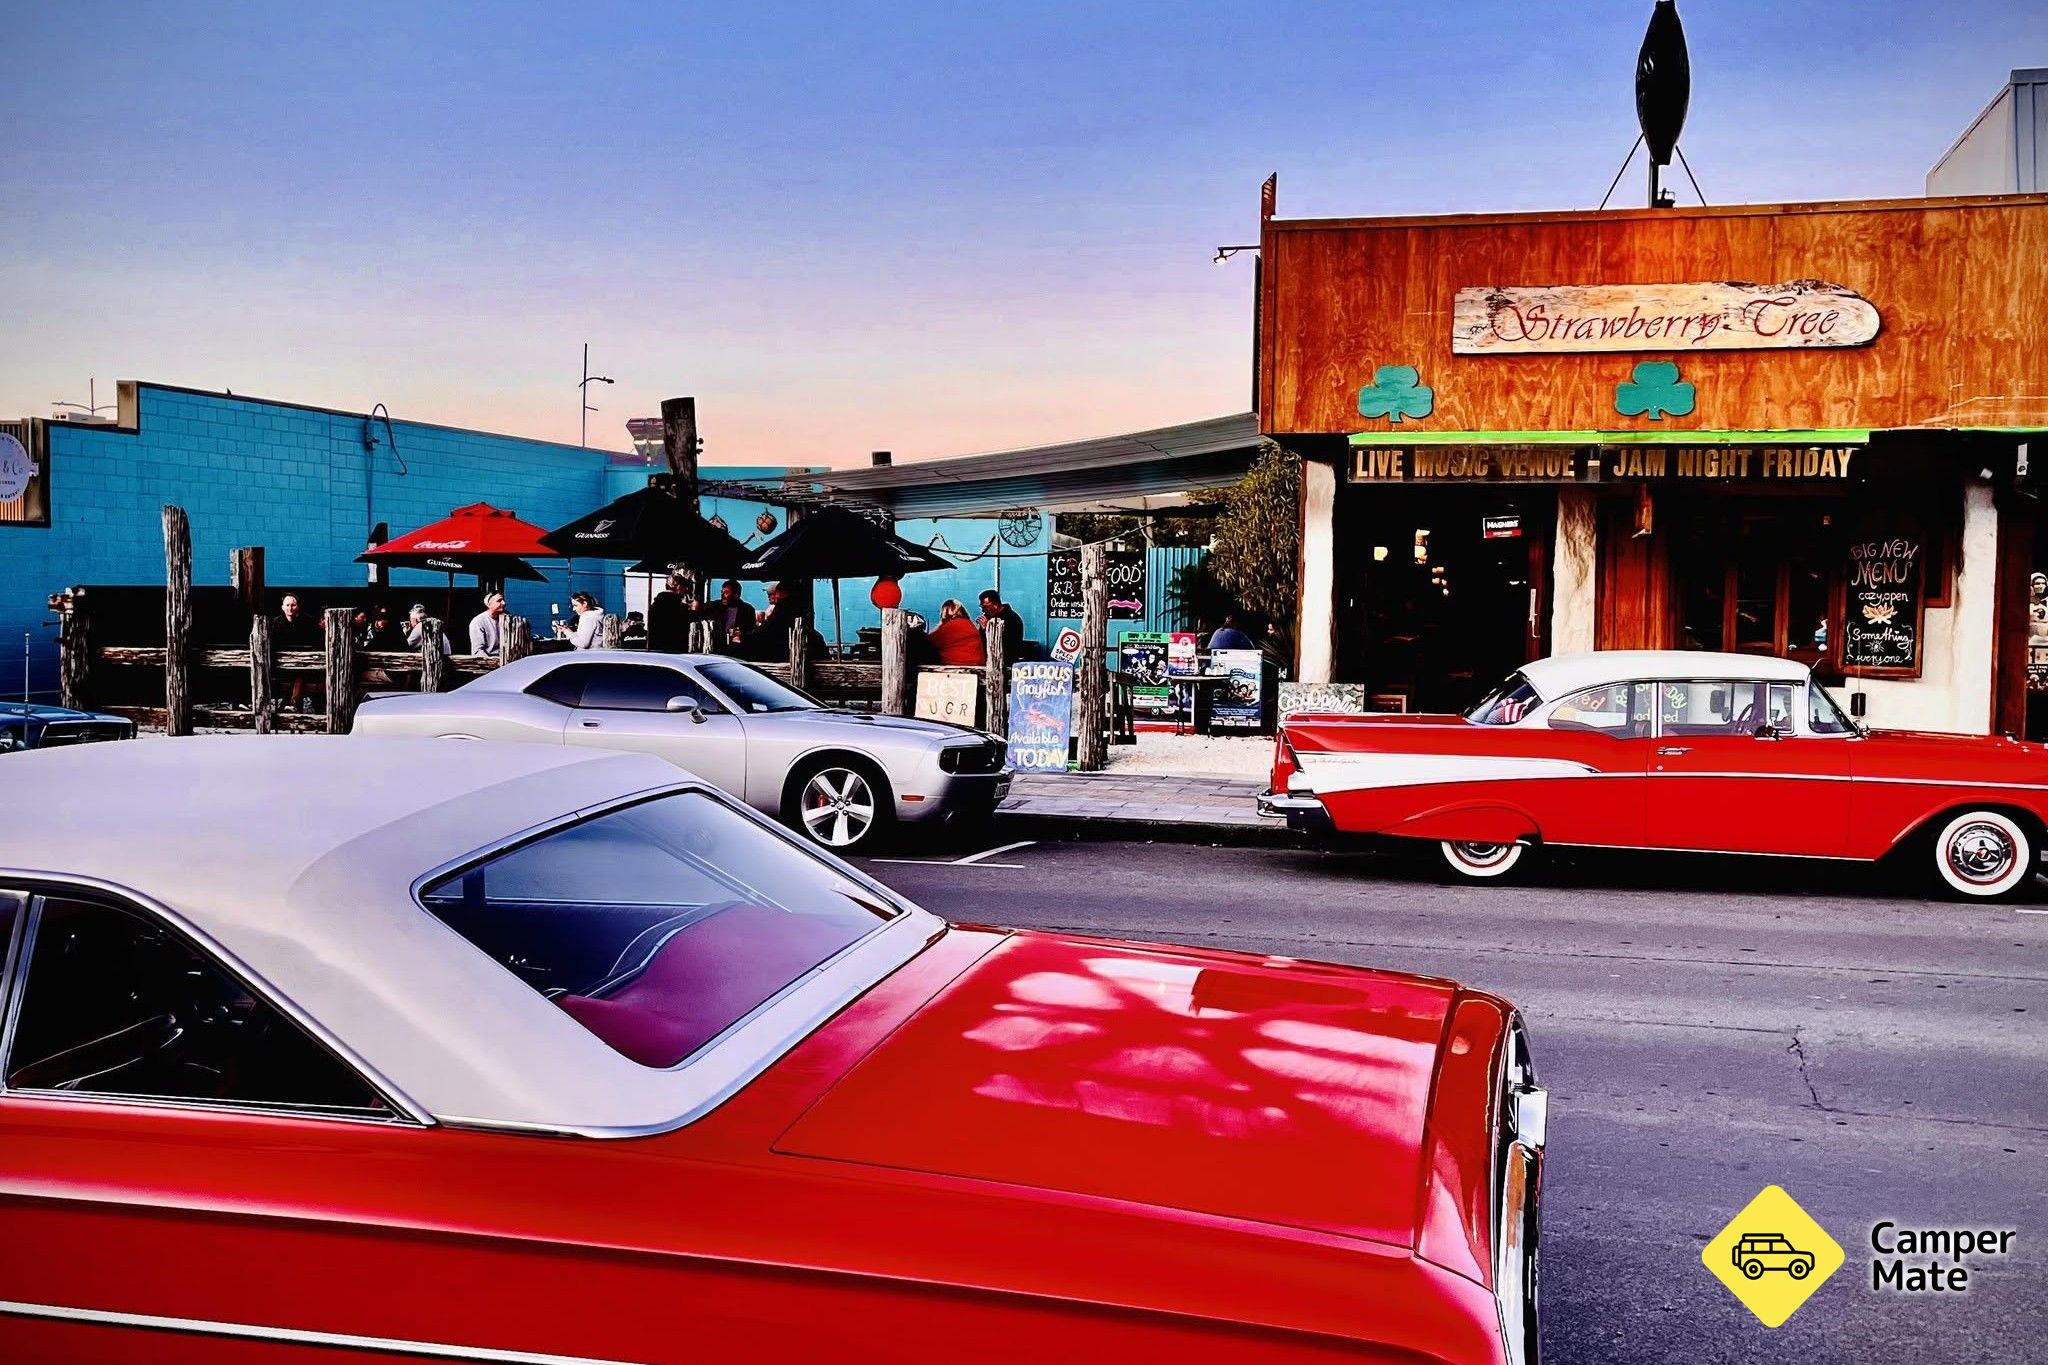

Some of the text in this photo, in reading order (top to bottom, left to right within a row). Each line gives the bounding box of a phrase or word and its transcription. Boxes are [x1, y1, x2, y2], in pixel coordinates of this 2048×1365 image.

[1496, 296, 1840, 345] Strawberry Tree
[1356, 450, 1403, 477] LIVE
[1414, 450, 1490, 477] MUSIC
[1501, 450, 1575, 477] VENUE
[1613, 449, 1665, 477] JAM
[1677, 449, 1751, 477] NIGHT
[1762, 448, 1853, 478] FRIDAY
[1850, 539, 1918, 560] BIG NEW
[426, 558, 463, 568] GUINNESS
[1851, 559, 1913, 590] MENU
[1050, 598, 1069, 608] Order
[1063, 637, 1077, 648] 20
[1012, 664, 1071, 682] DELICIOUS
[1014, 747, 1069, 769] TODAY
